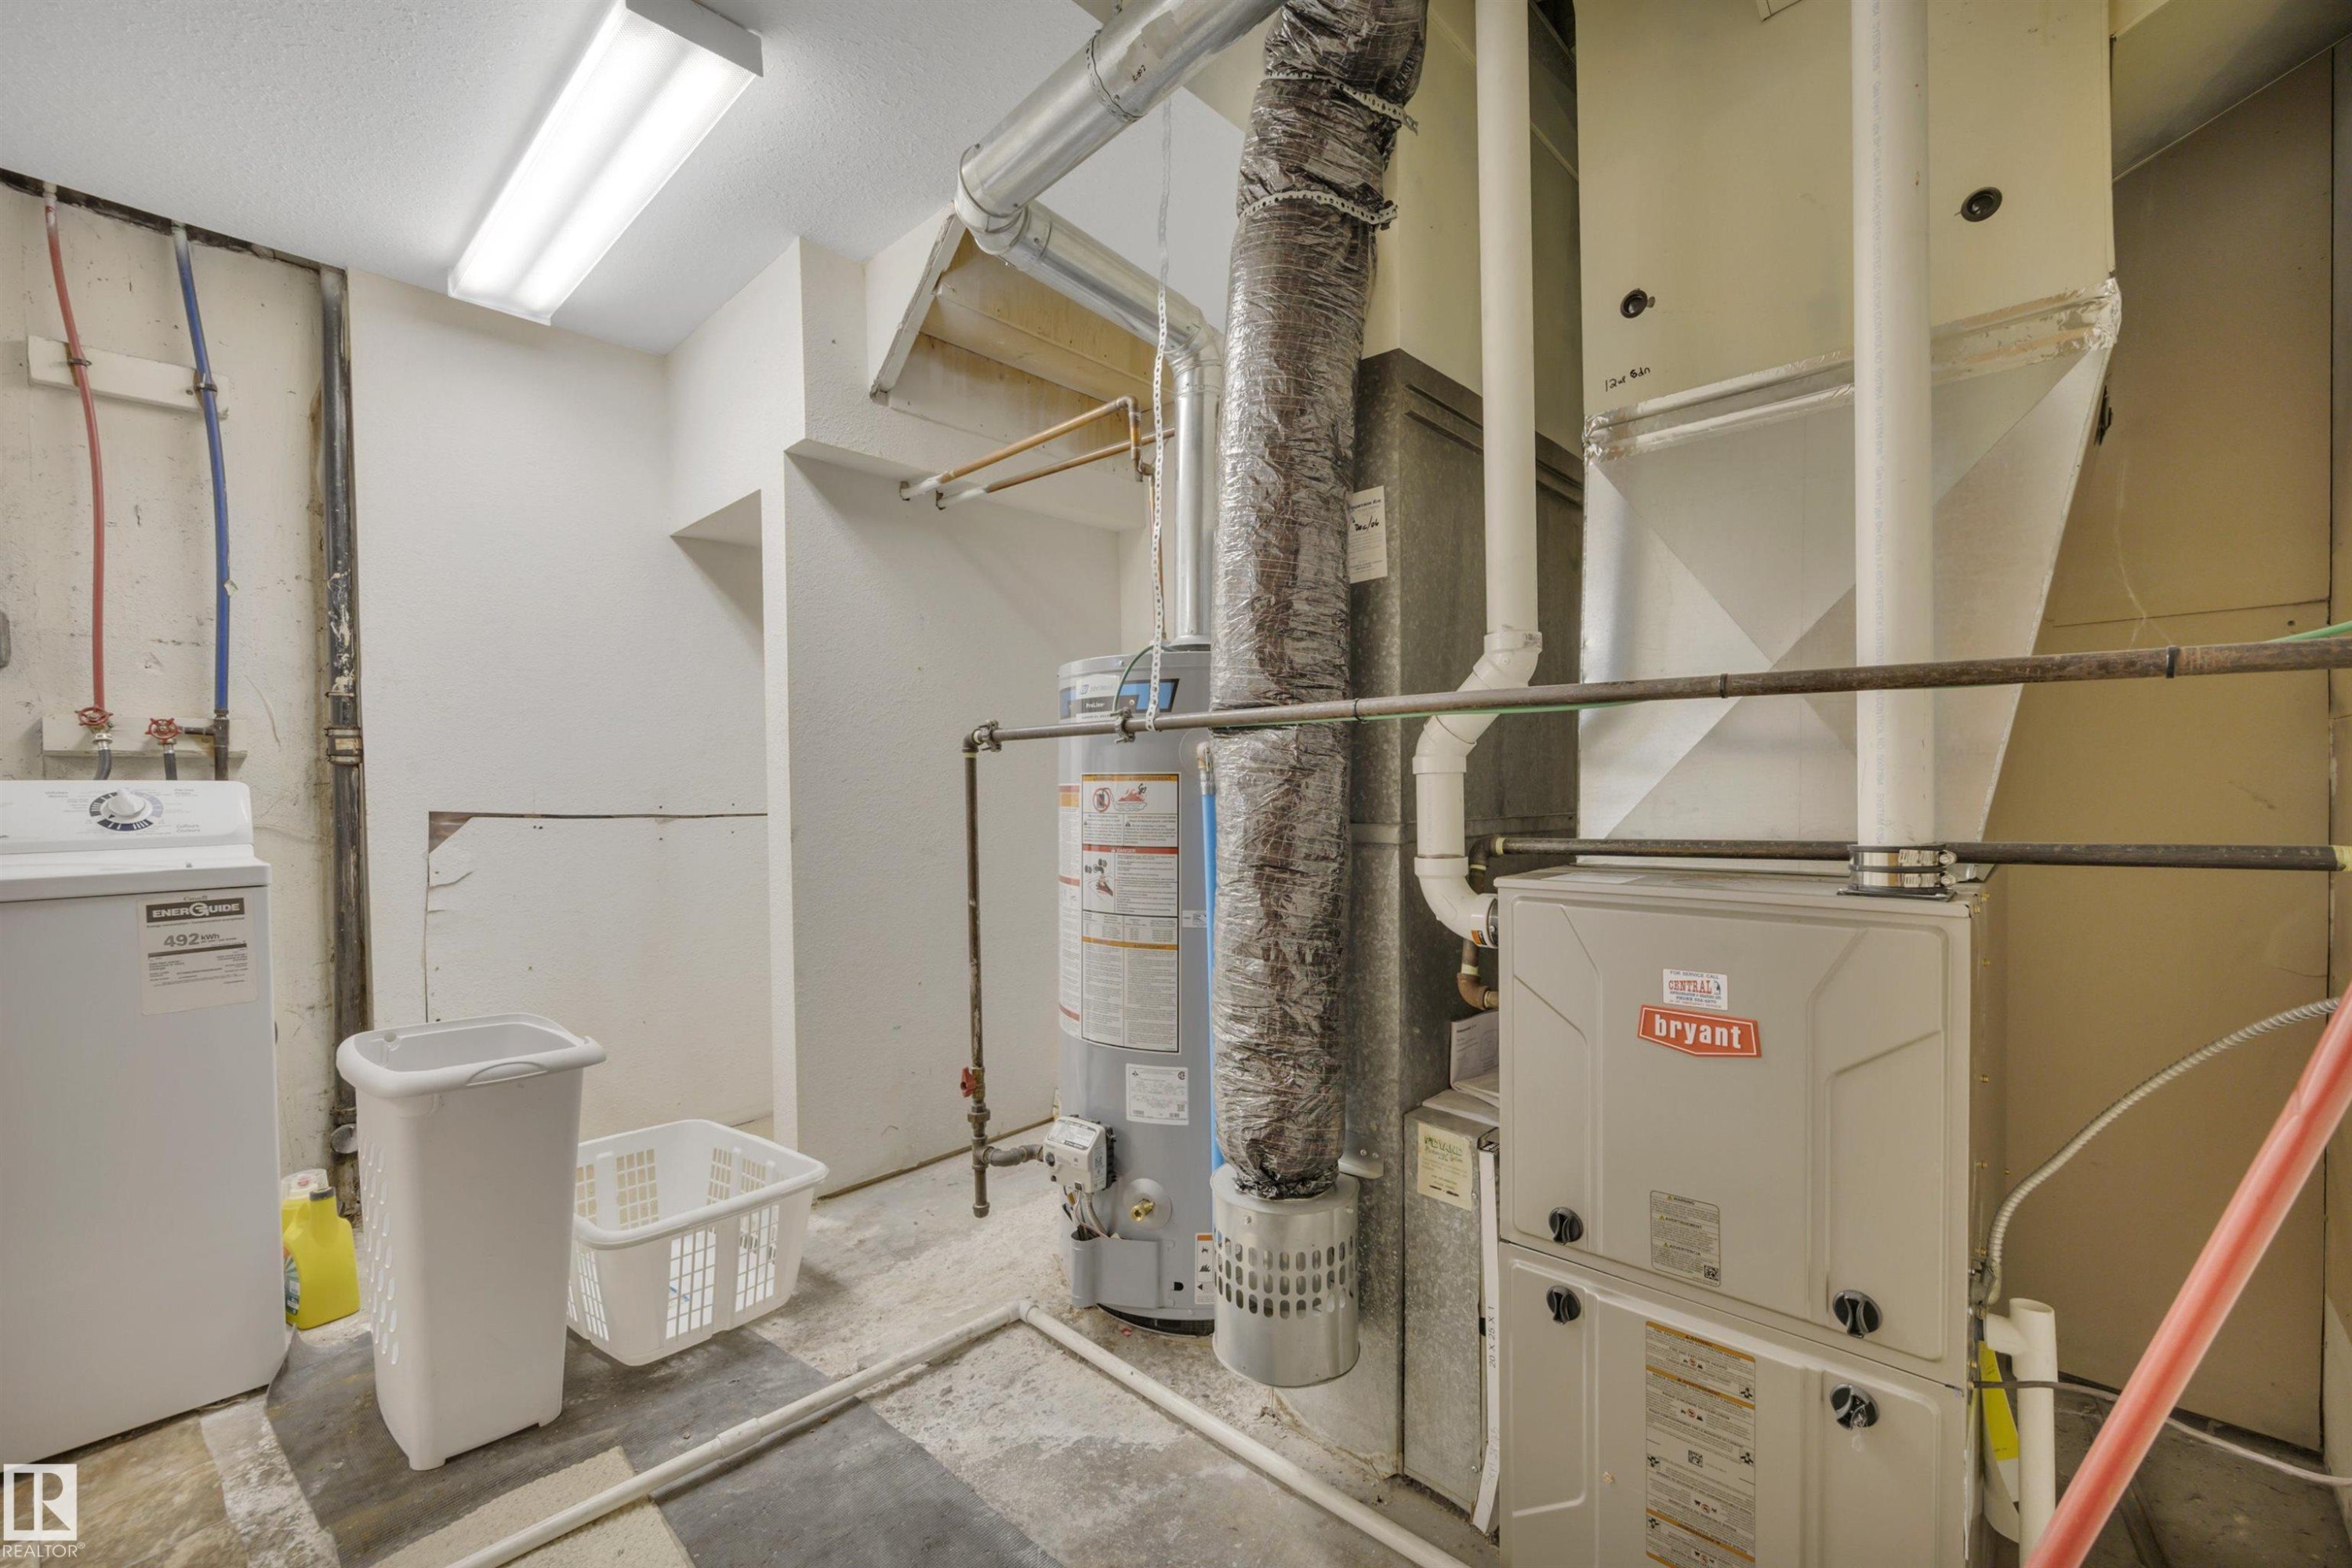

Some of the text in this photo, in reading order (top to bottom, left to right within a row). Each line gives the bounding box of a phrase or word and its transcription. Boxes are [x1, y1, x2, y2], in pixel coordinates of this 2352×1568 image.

[152, 902, 240, 918] ENERGUIDE
[164, 933, 200, 947] 492
[1668, 980, 1712, 994] CENTRAL
[1654, 1014, 1742, 1049] bryant
[1488, 1327, 1495, 1341] 25
[1489, 1355, 1496, 1369] 20
